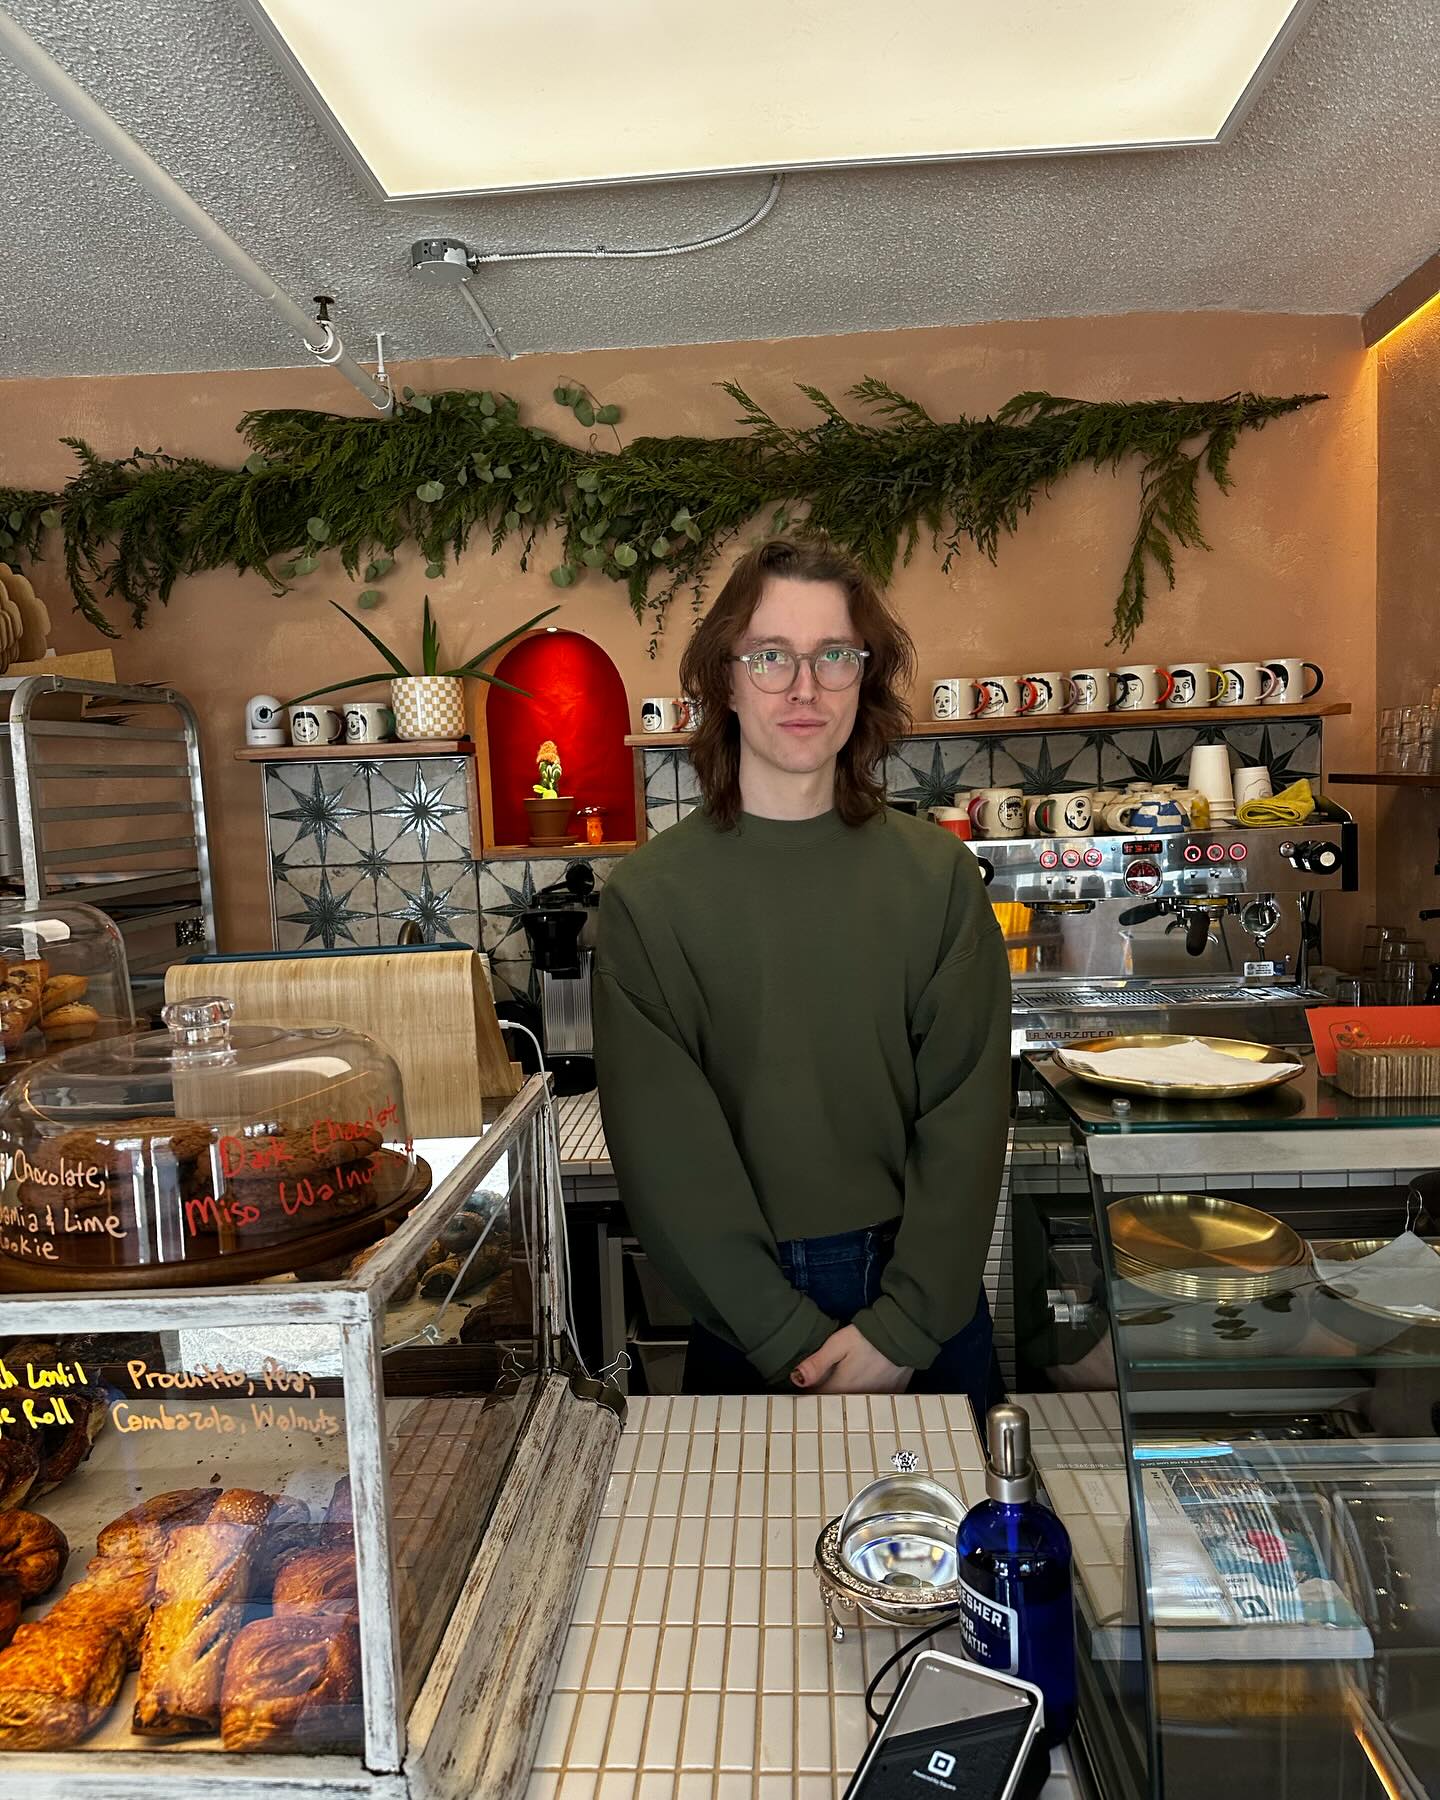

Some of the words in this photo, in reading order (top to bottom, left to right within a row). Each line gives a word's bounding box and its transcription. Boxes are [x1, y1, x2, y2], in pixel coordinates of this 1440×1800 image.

[14, 1149, 106, 1196] Chocolate,
[219, 1136, 294, 1178] Dark
[0, 1204, 39, 1233] amia
[64, 1207, 128, 1239] Lime
[185, 1195, 261, 1237] Miso
[0, 1235, 59, 1260] ookie
[22, 1397, 75, 1430] Roll
